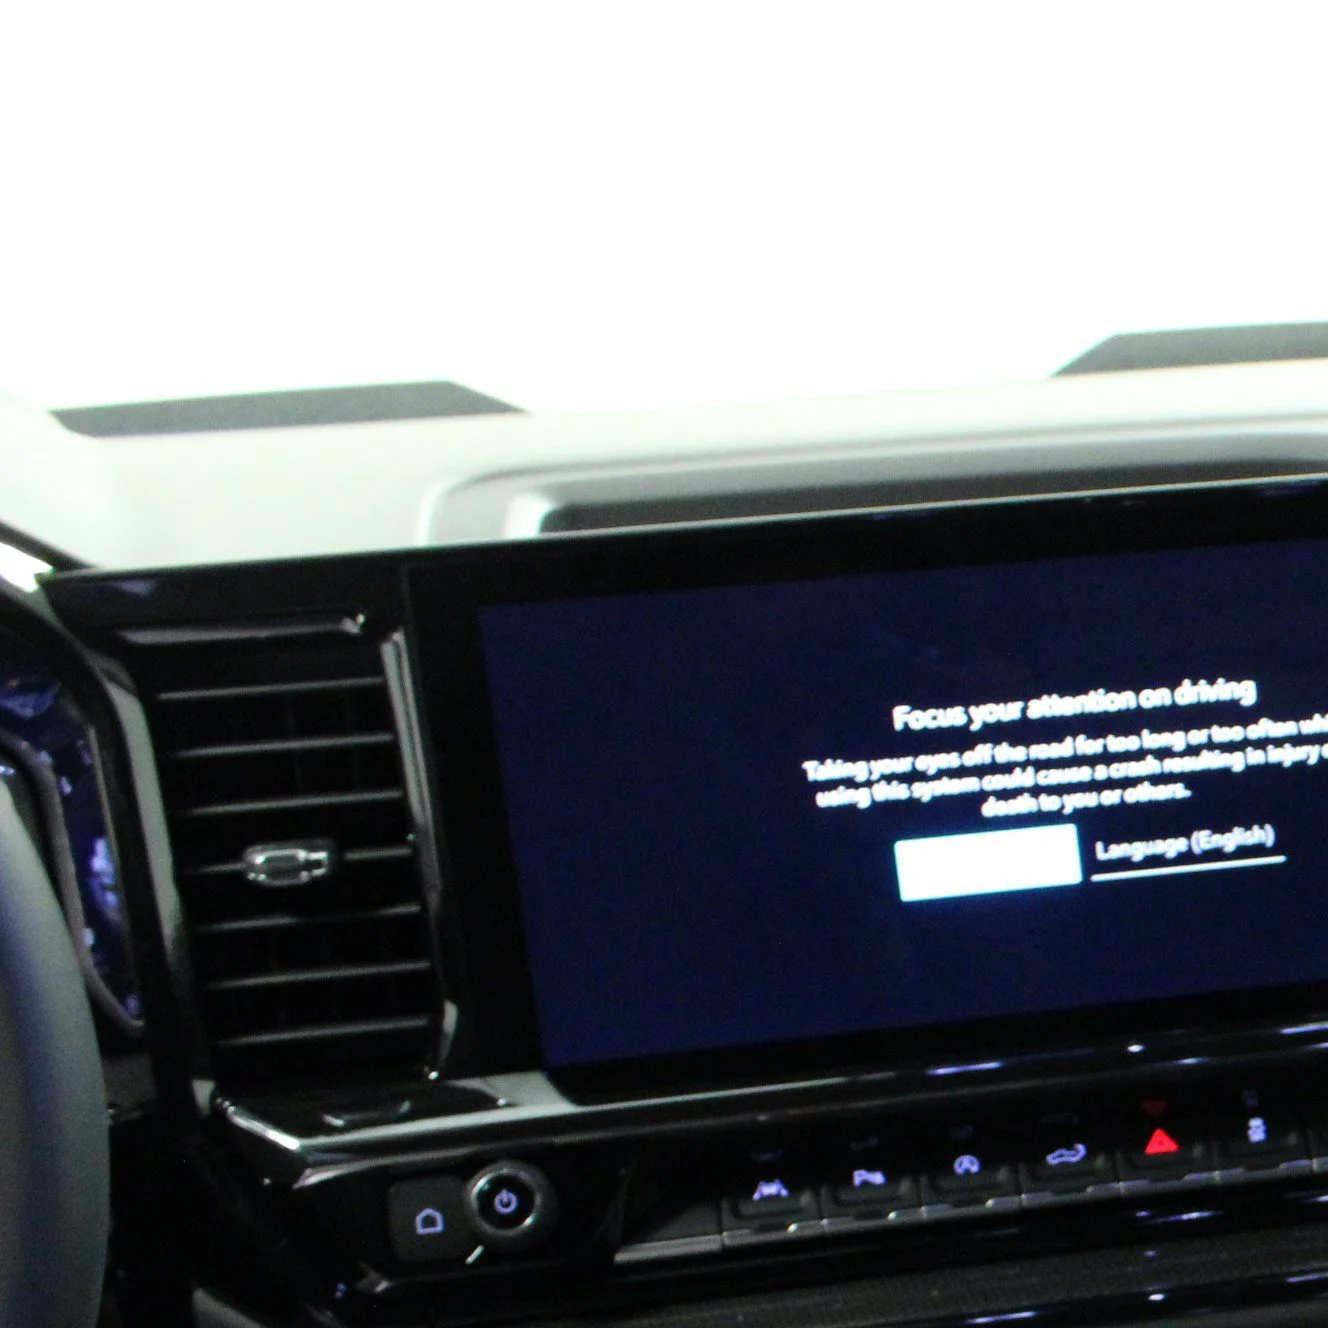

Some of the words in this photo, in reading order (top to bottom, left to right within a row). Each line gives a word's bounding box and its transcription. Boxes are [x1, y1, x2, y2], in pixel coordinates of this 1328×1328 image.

[892, 705, 968, 731] Focus
[969, 701, 1024, 731] your
[1026, 688, 1137, 719] attention
[1138, 687, 1172, 709] on
[1173, 678, 1257, 707] driving
[802, 759, 868, 782] Taking
[869, 756, 913, 780] your
[914, 752, 961, 775] eyes
[961, 743, 993, 767] off
[993, 741, 1027, 764] the
[1028, 736, 1074, 760] road
[1075, 734, 1104, 755] for
[1106, 734, 1140, 753] too
[1141, 728, 1186, 752] long
[1187, 728, 1210, 746] or
[1210, 724, 1245, 743] too
[1245, 717, 1298, 740] often
[815, 785, 871, 809] using
[871, 780, 911, 803] this
[911, 776, 980, 803] system
[981, 765, 1035, 791] could
[1036, 765, 1092, 786] cause
[1093, 764, 1108, 781] a
[1108, 754, 1161, 779] crash
[1162, 749, 1246, 773] resulting
[1246, 746, 1266, 766] in
[1267, 742, 1321, 768] injury
[981, 793, 1038, 818] death
[1038, 793, 1062, 812] to
[1062, 790, 1099, 815] you
[1099, 789, 1122, 806] or
[1123, 780, 1192, 804] others.
[1095, 837, 1189, 863] Language
[1190, 823, 1275, 855] (English)
